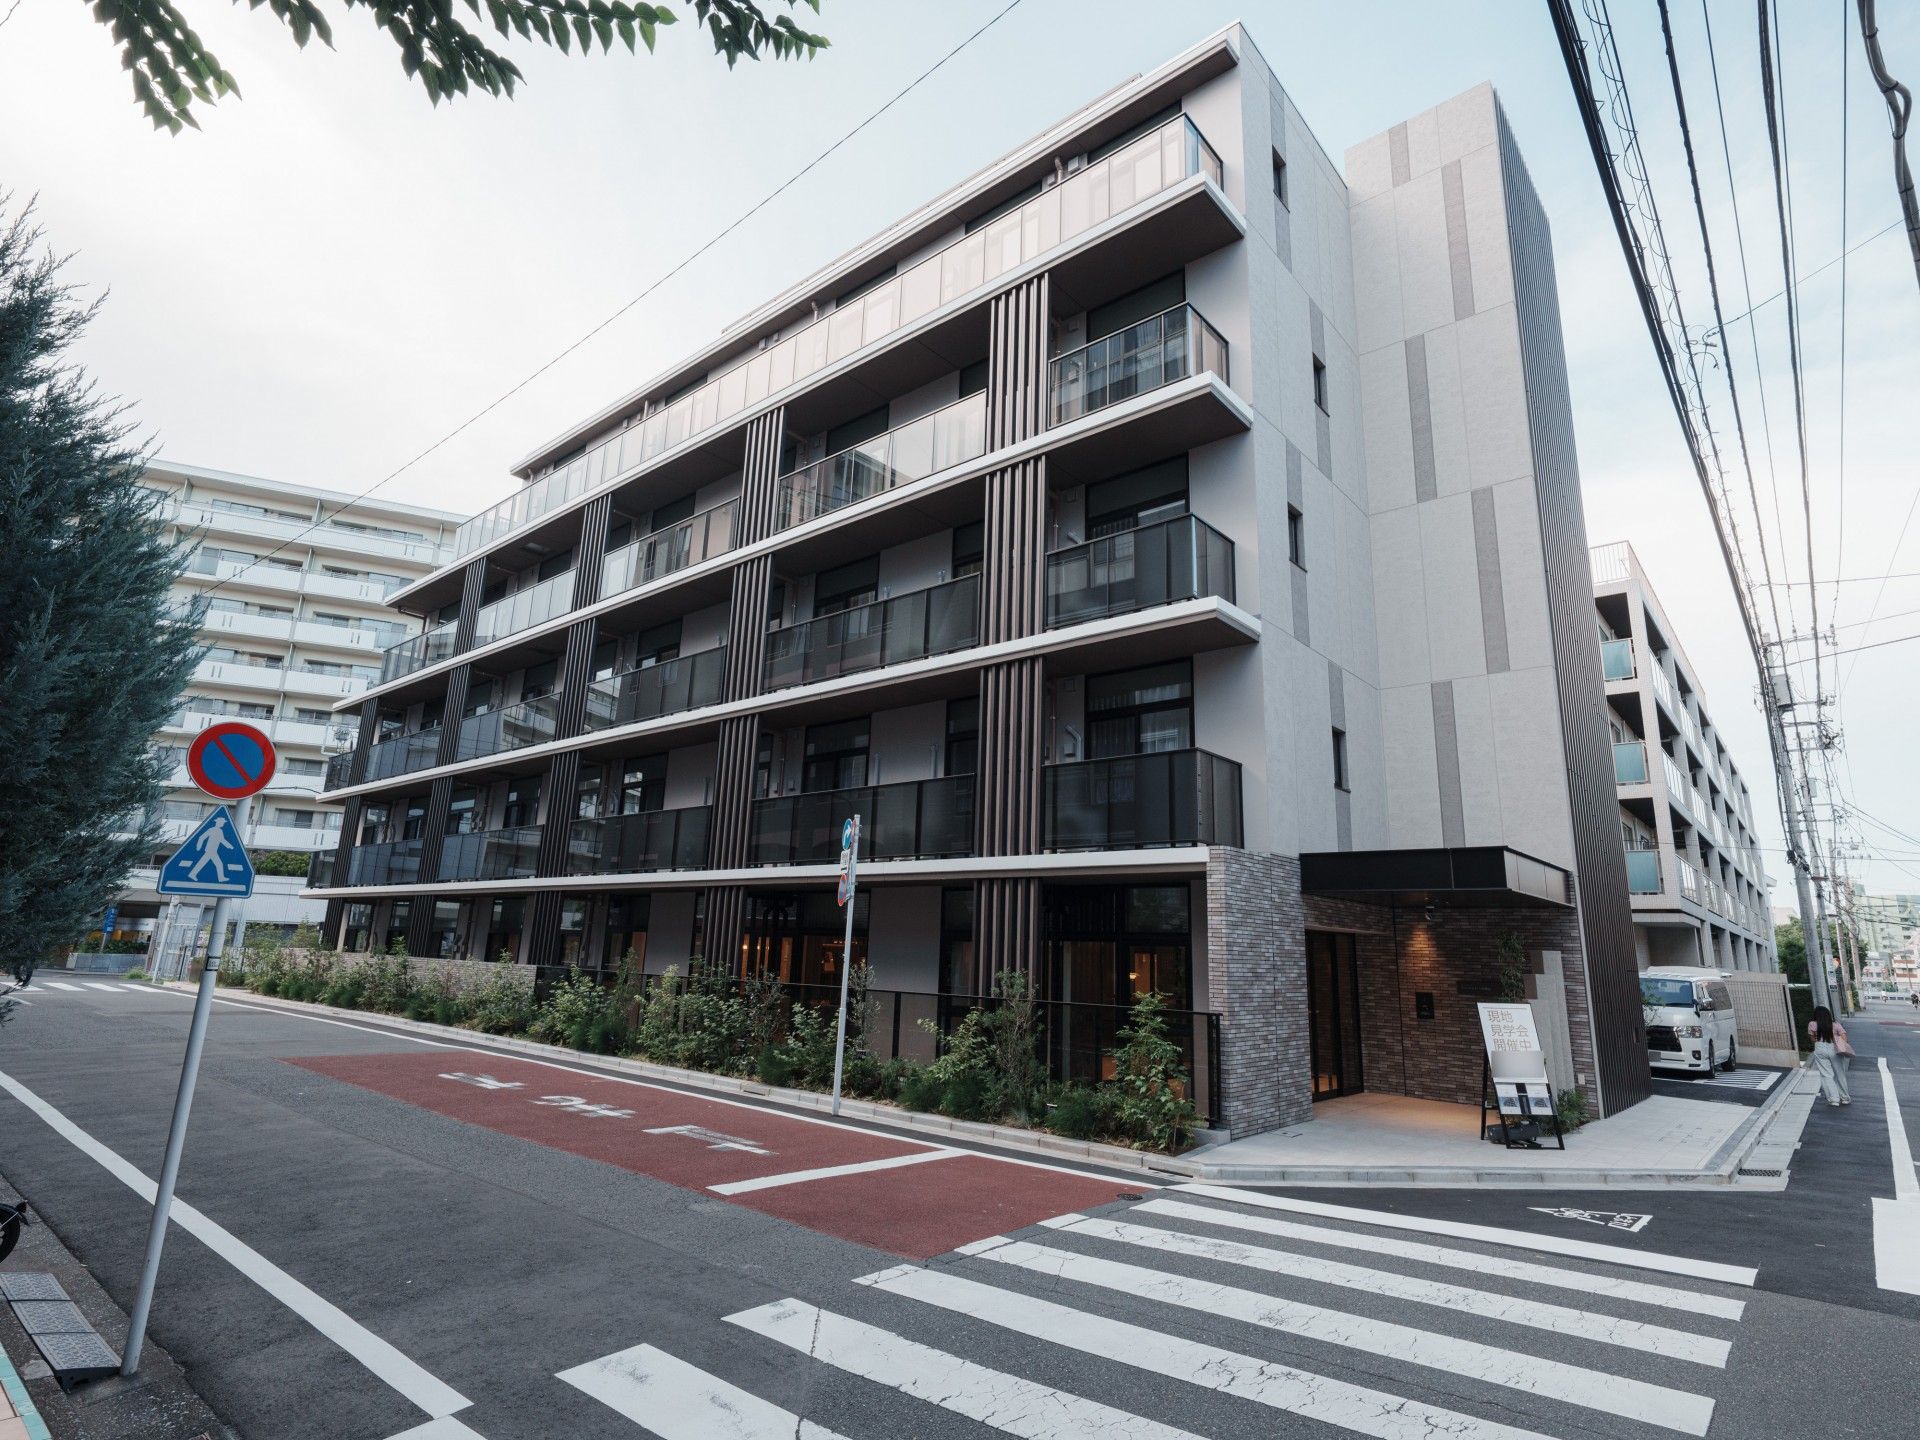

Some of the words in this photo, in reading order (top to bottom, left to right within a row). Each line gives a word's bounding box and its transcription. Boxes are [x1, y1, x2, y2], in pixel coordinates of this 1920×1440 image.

[1487, 1010, 1513, 1022] 現地
[1491, 1025, 1528, 1037] 見学会
[1493, 1039, 1531, 1051] 開催中
